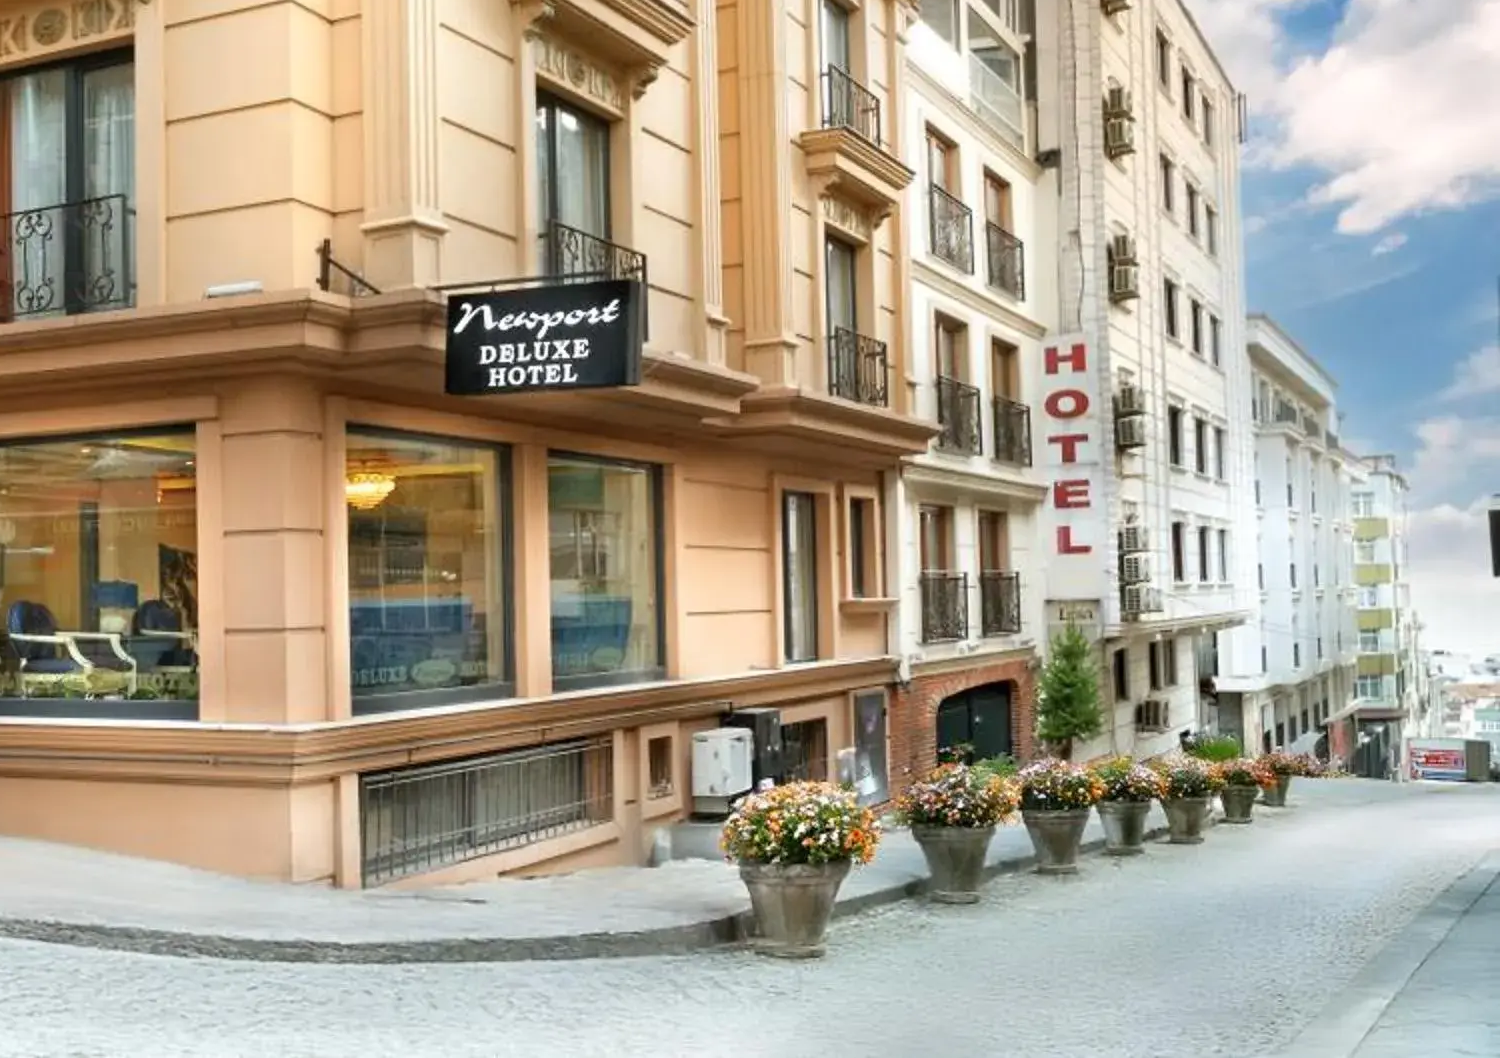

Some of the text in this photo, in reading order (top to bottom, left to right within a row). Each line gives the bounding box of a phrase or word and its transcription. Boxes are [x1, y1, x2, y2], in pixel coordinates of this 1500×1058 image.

[453, 298, 620, 339] Newport
[479, 338, 590, 365] DELUXE
[487, 363, 578, 388] HOTEL
[1043, 342, 1092, 555] HOTEL
